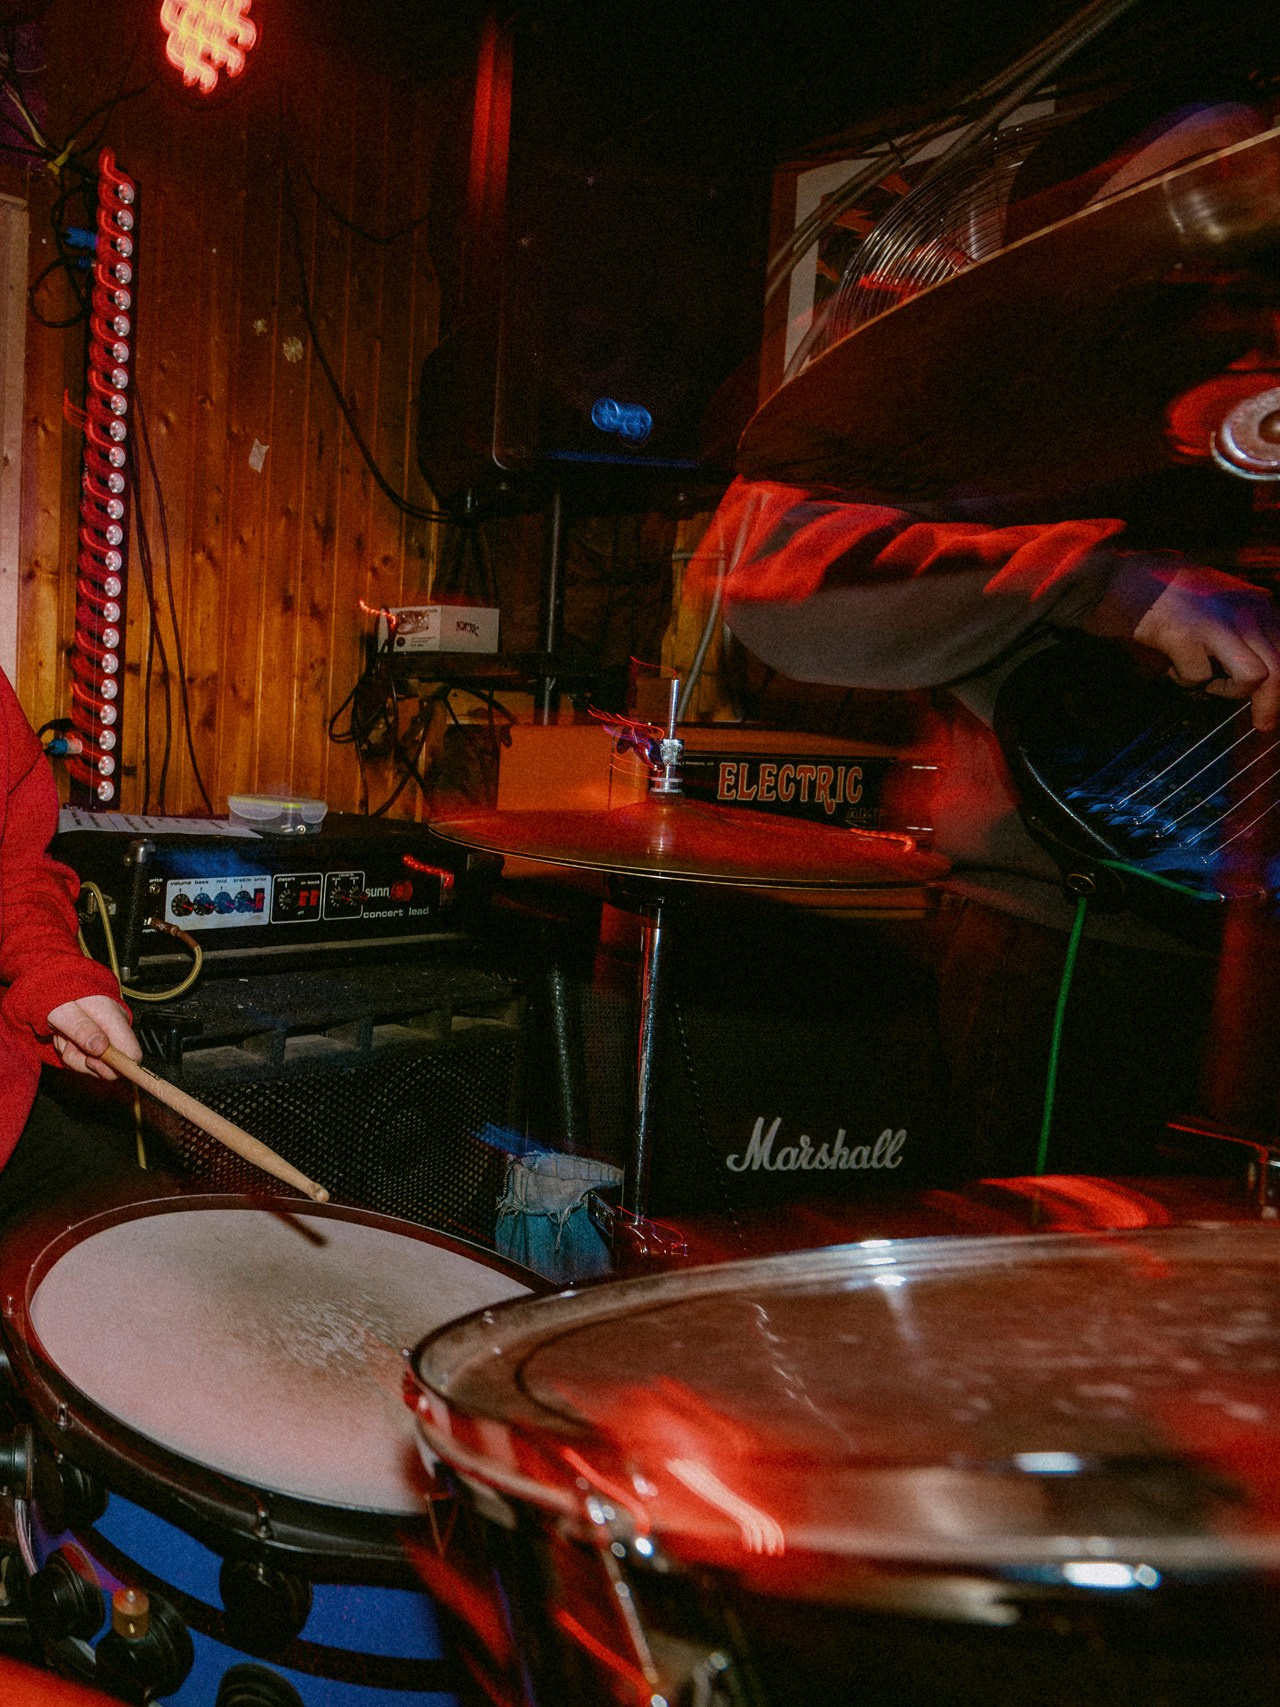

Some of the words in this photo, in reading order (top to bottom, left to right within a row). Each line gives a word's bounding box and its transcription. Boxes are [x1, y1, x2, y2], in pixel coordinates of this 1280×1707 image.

[717, 762, 863, 815] ELECTRIC
[365, 887, 389, 898] sunn
[363, 909, 404, 919] concert
[408, 907, 429, 916] lead
[726, 1116, 907, 1172] Marshall
